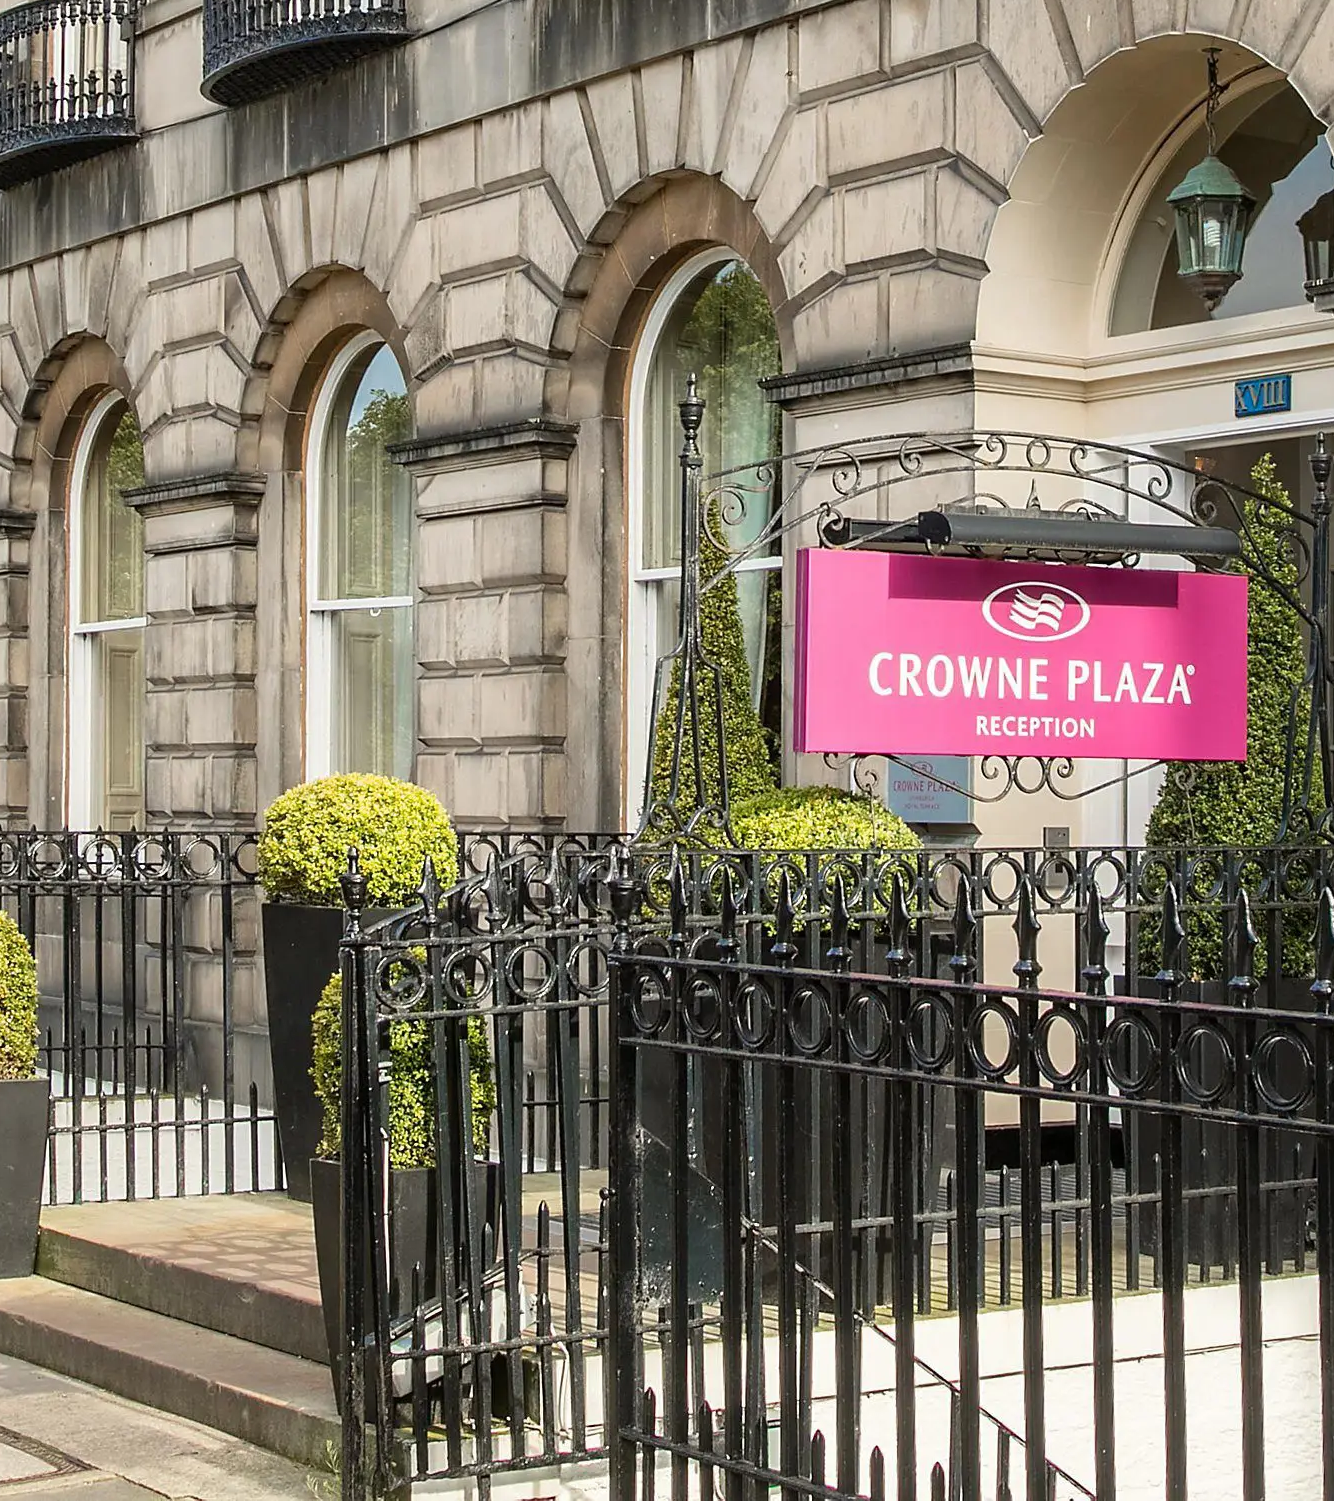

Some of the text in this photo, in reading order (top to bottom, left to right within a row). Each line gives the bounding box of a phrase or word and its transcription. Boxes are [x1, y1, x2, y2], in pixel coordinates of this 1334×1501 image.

[1235, 380, 1286, 411] XVIII
[869, 652, 1049, 701] CROWNE
[976, 715, 1095, 739] RECEPTION
[893, 780, 925, 792] CROWNE
